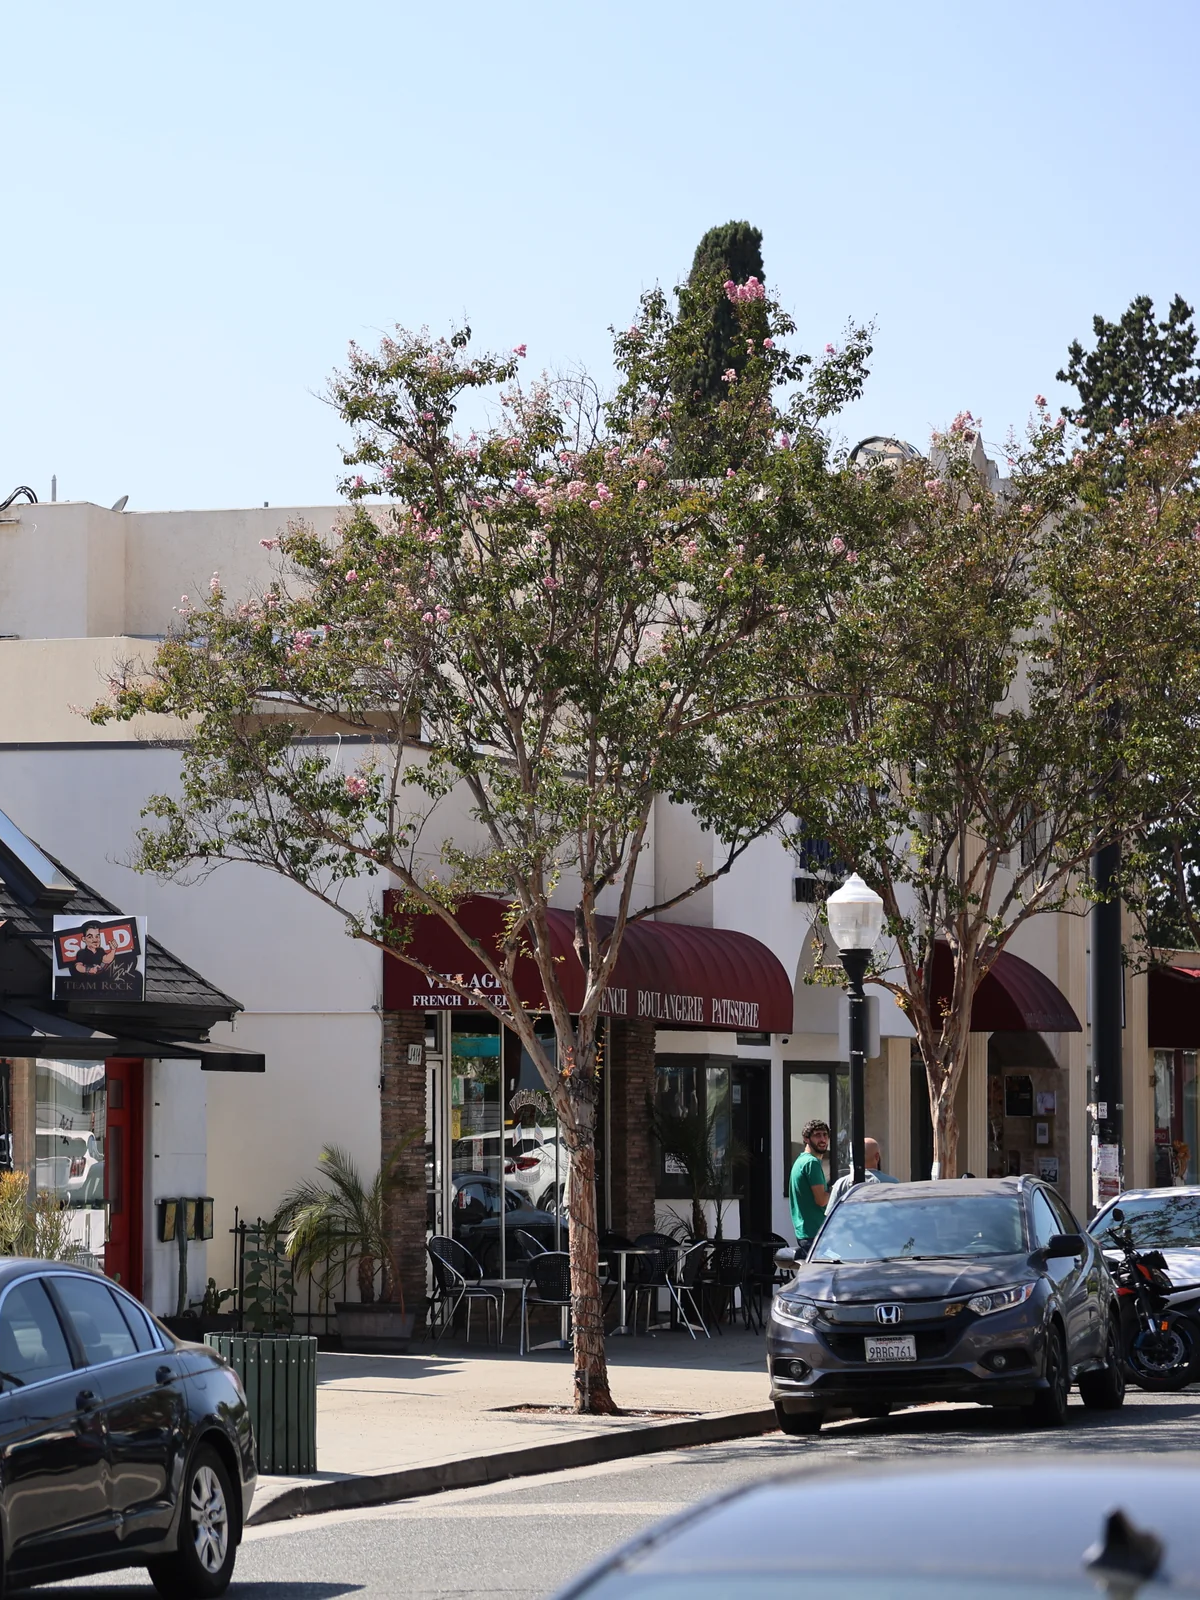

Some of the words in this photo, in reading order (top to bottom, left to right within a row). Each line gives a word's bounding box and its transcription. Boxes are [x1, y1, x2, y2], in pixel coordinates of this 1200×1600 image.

[64, 928, 131, 958] SLD
[64, 981, 96, 990] TEAM
[102, 981, 134, 990] ROCK
[413, 995, 461, 1006] FRENCH
[638, 990, 704, 1022] BOULANGERIE
[712, 998, 759, 1028] PATISSERIE
[509, 1088, 548, 1116] VILLAGE
